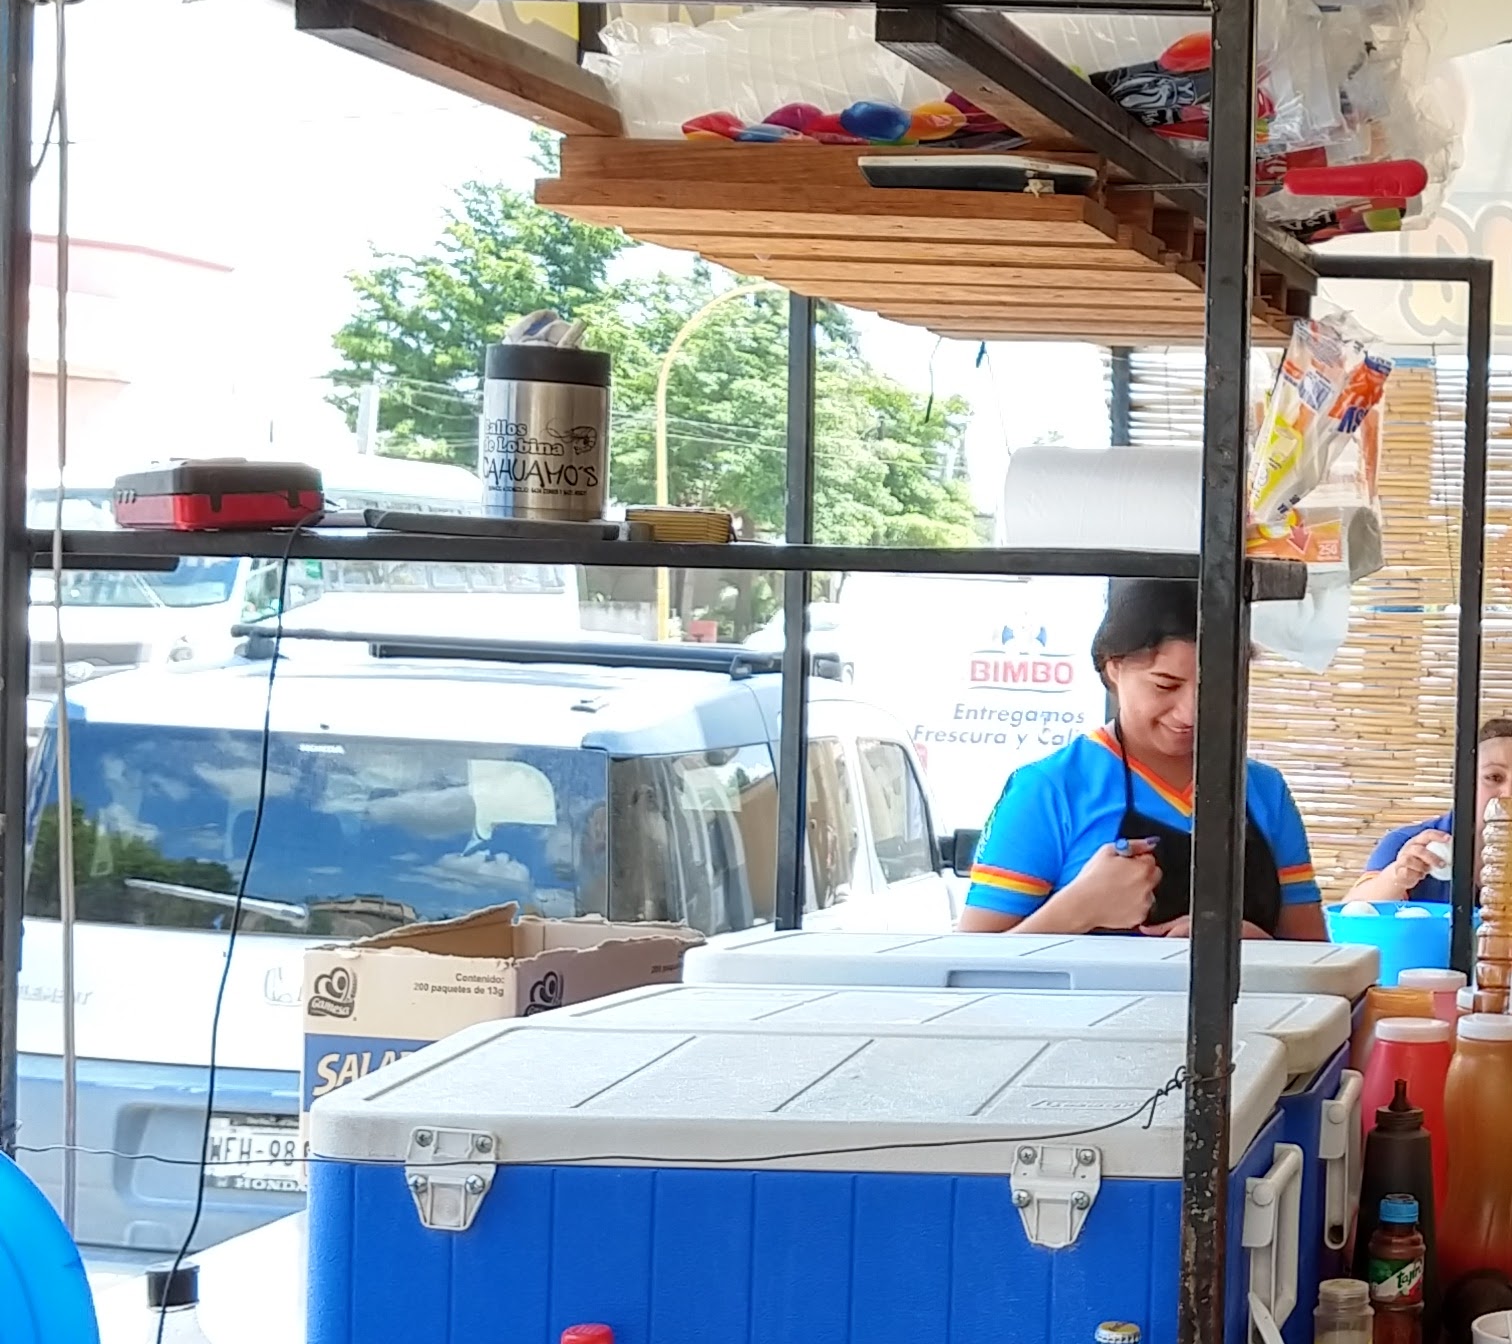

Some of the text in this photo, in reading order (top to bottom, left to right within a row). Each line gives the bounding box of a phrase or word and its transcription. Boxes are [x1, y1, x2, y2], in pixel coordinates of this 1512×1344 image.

[484, 419, 527, 436] allos
[497, 436, 564, 456] Lobina
[970, 660, 1073, 685] BIMBO
[953, 703, 1085, 727] Entregamos
[913, 725, 1007, 744] Frescura
[1016, 733, 1028, 750] y
[455, 973, 505, 984] Contenido:
[413, 982, 504, 998] 200 paquetes de 13g
[311, 998, 350, 1016] Gamesa
